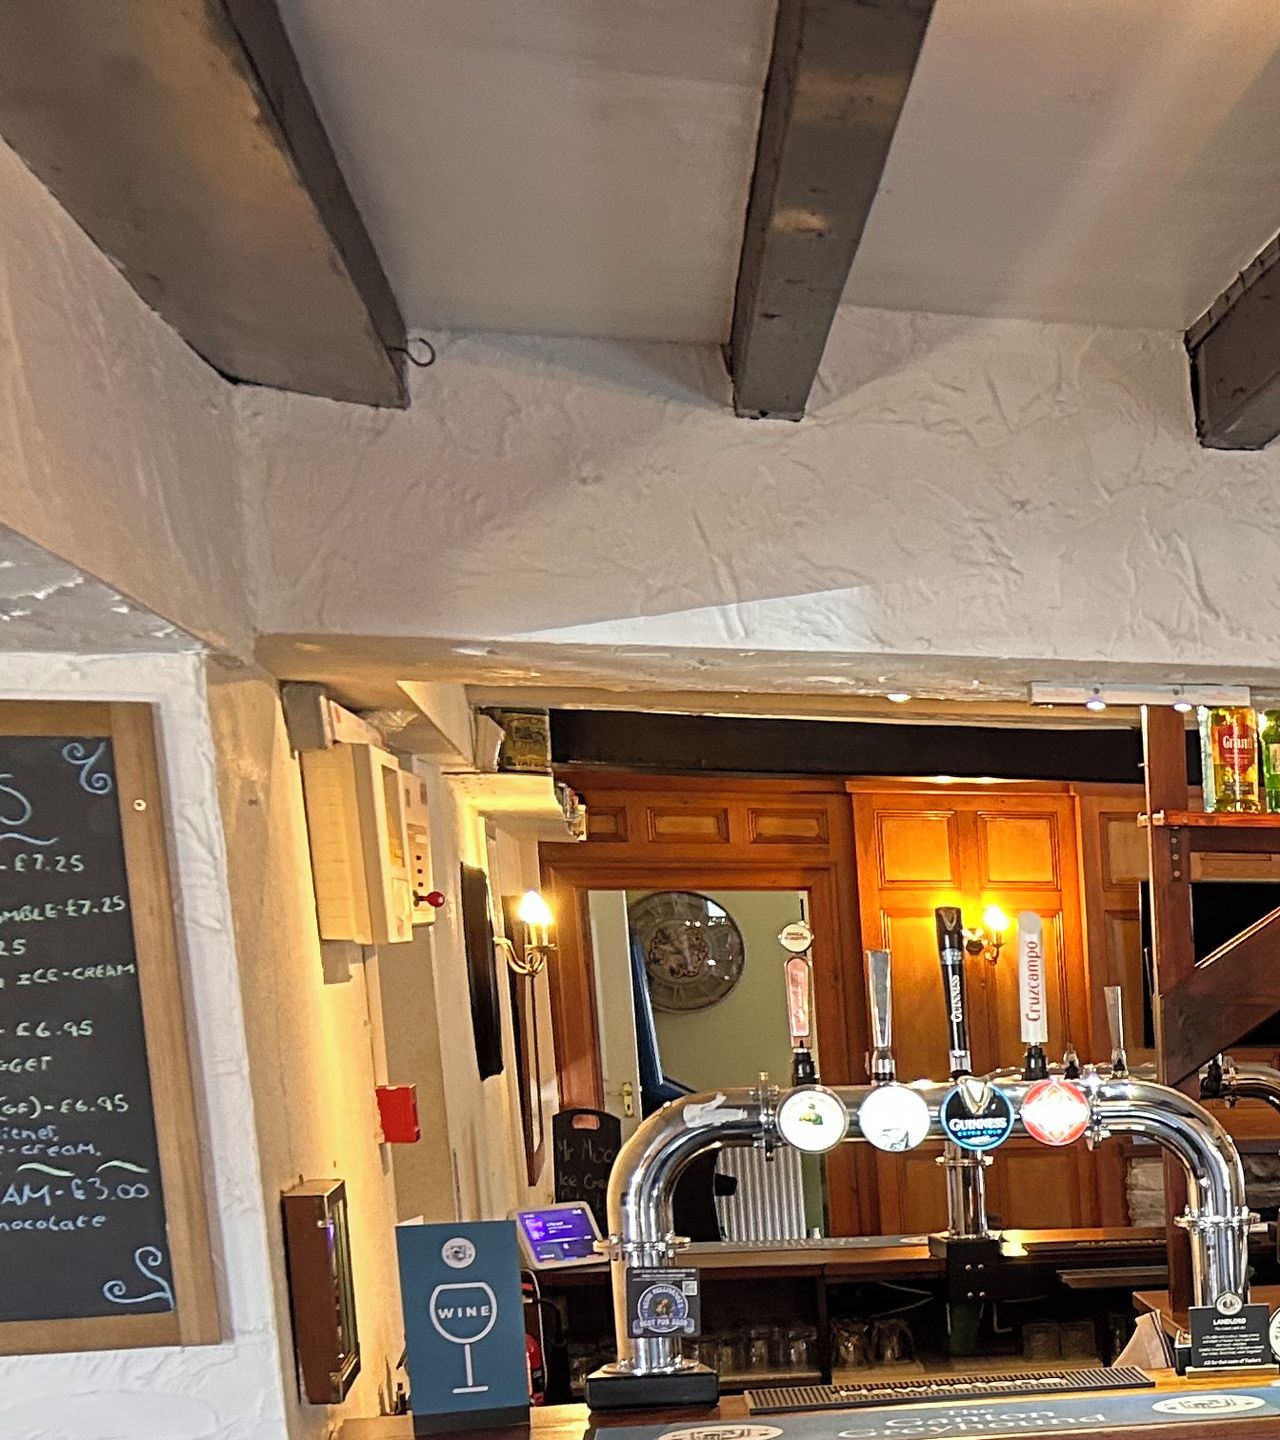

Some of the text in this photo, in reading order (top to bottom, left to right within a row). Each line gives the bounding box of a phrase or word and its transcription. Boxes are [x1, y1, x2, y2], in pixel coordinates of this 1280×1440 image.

[1025, 940, 1041, 1022] Cruzcampo
[948, 1116, 1008, 1132] GUINNESS
[437, 1304, 491, 1319] WINE
[837, 1376, 1068, 1397] Hawkstone
[837, 1412, 1107, 1438] Greyhound
